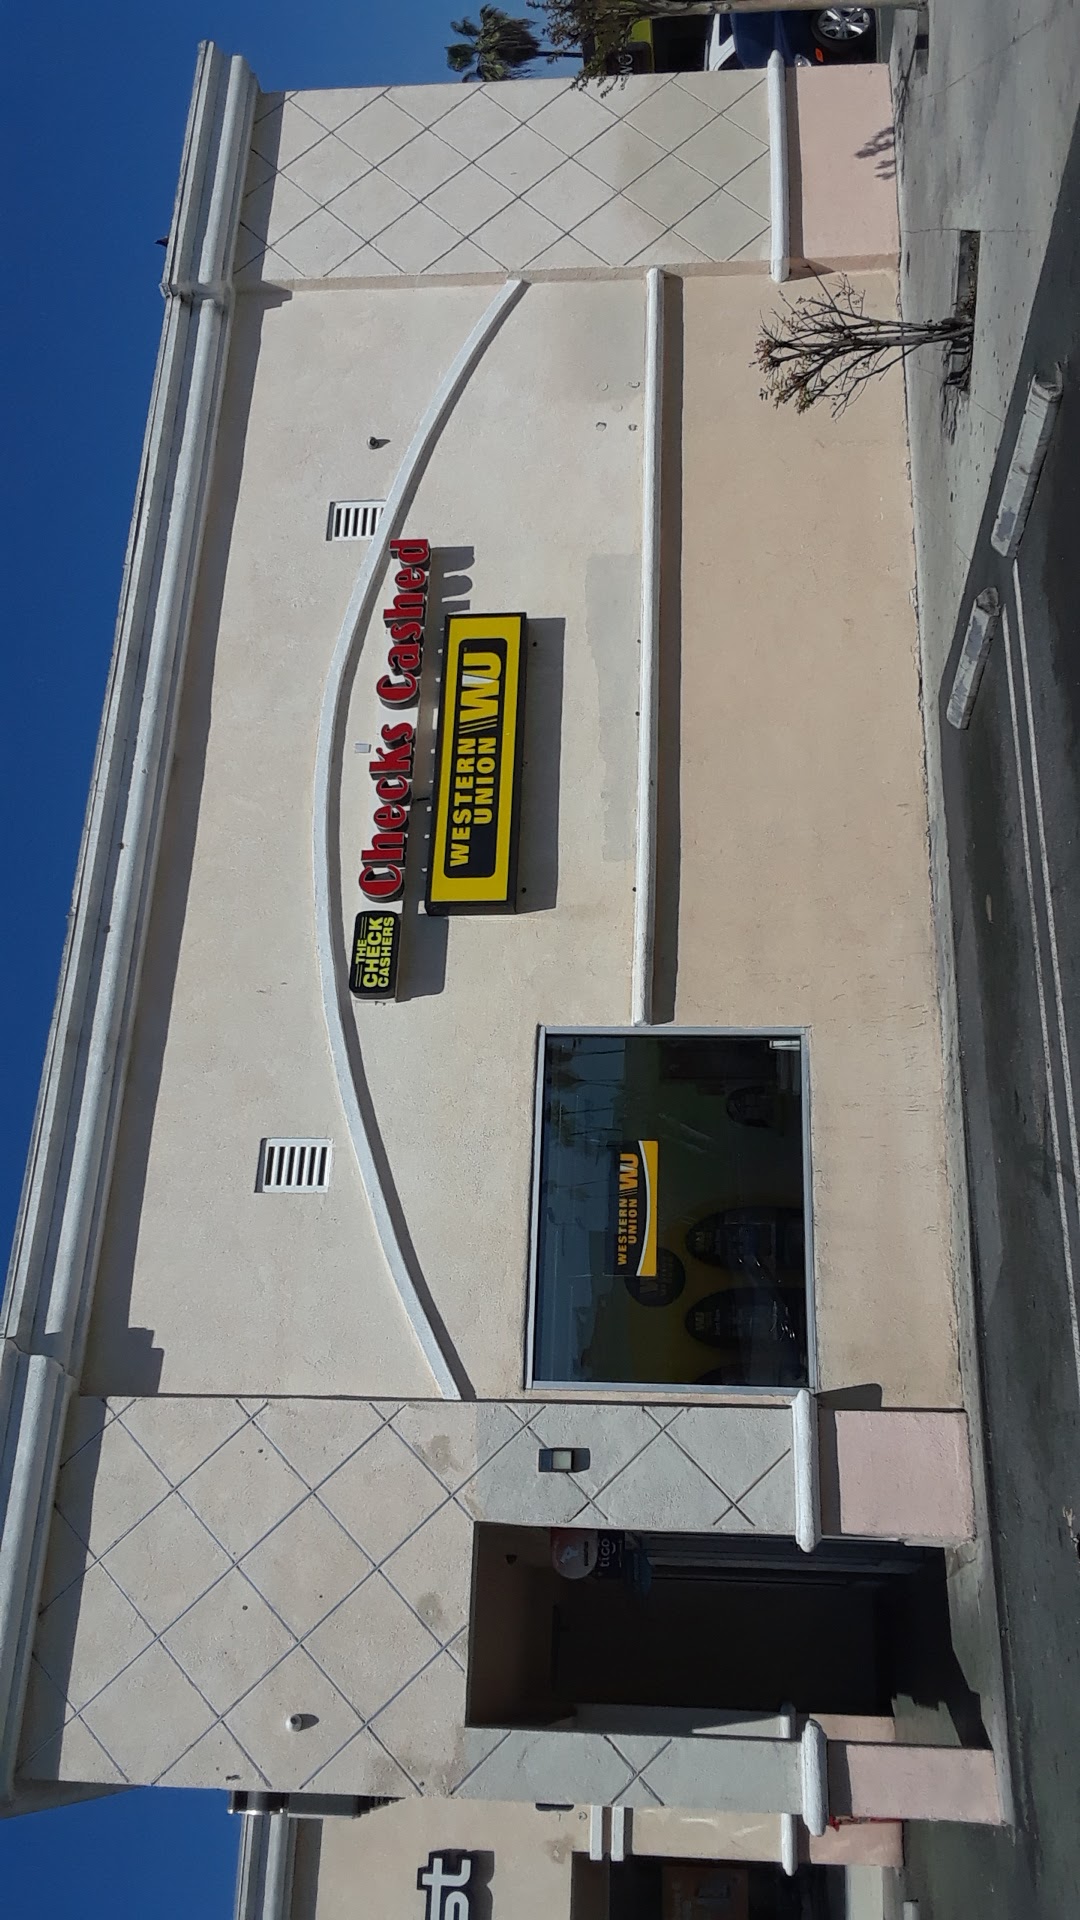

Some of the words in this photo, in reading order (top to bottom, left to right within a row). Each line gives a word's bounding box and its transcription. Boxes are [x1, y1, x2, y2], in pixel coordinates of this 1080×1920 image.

[376, 538, 430, 703] Cashed
[459, 651, 502, 723] WU
[358, 722, 414, 898] Checks
[449, 737, 476, 868] WESTERN
[473, 737, 497, 825] UNION
[355, 939, 367, 965] THE
[363, 917, 383, 988] CHECK
[377, 916, 395, 988] CASHERS
[619, 1152, 640, 1191] WU
[617, 1198, 628, 1266] WESTERN
[628, 1198, 638, 1244] UNION
